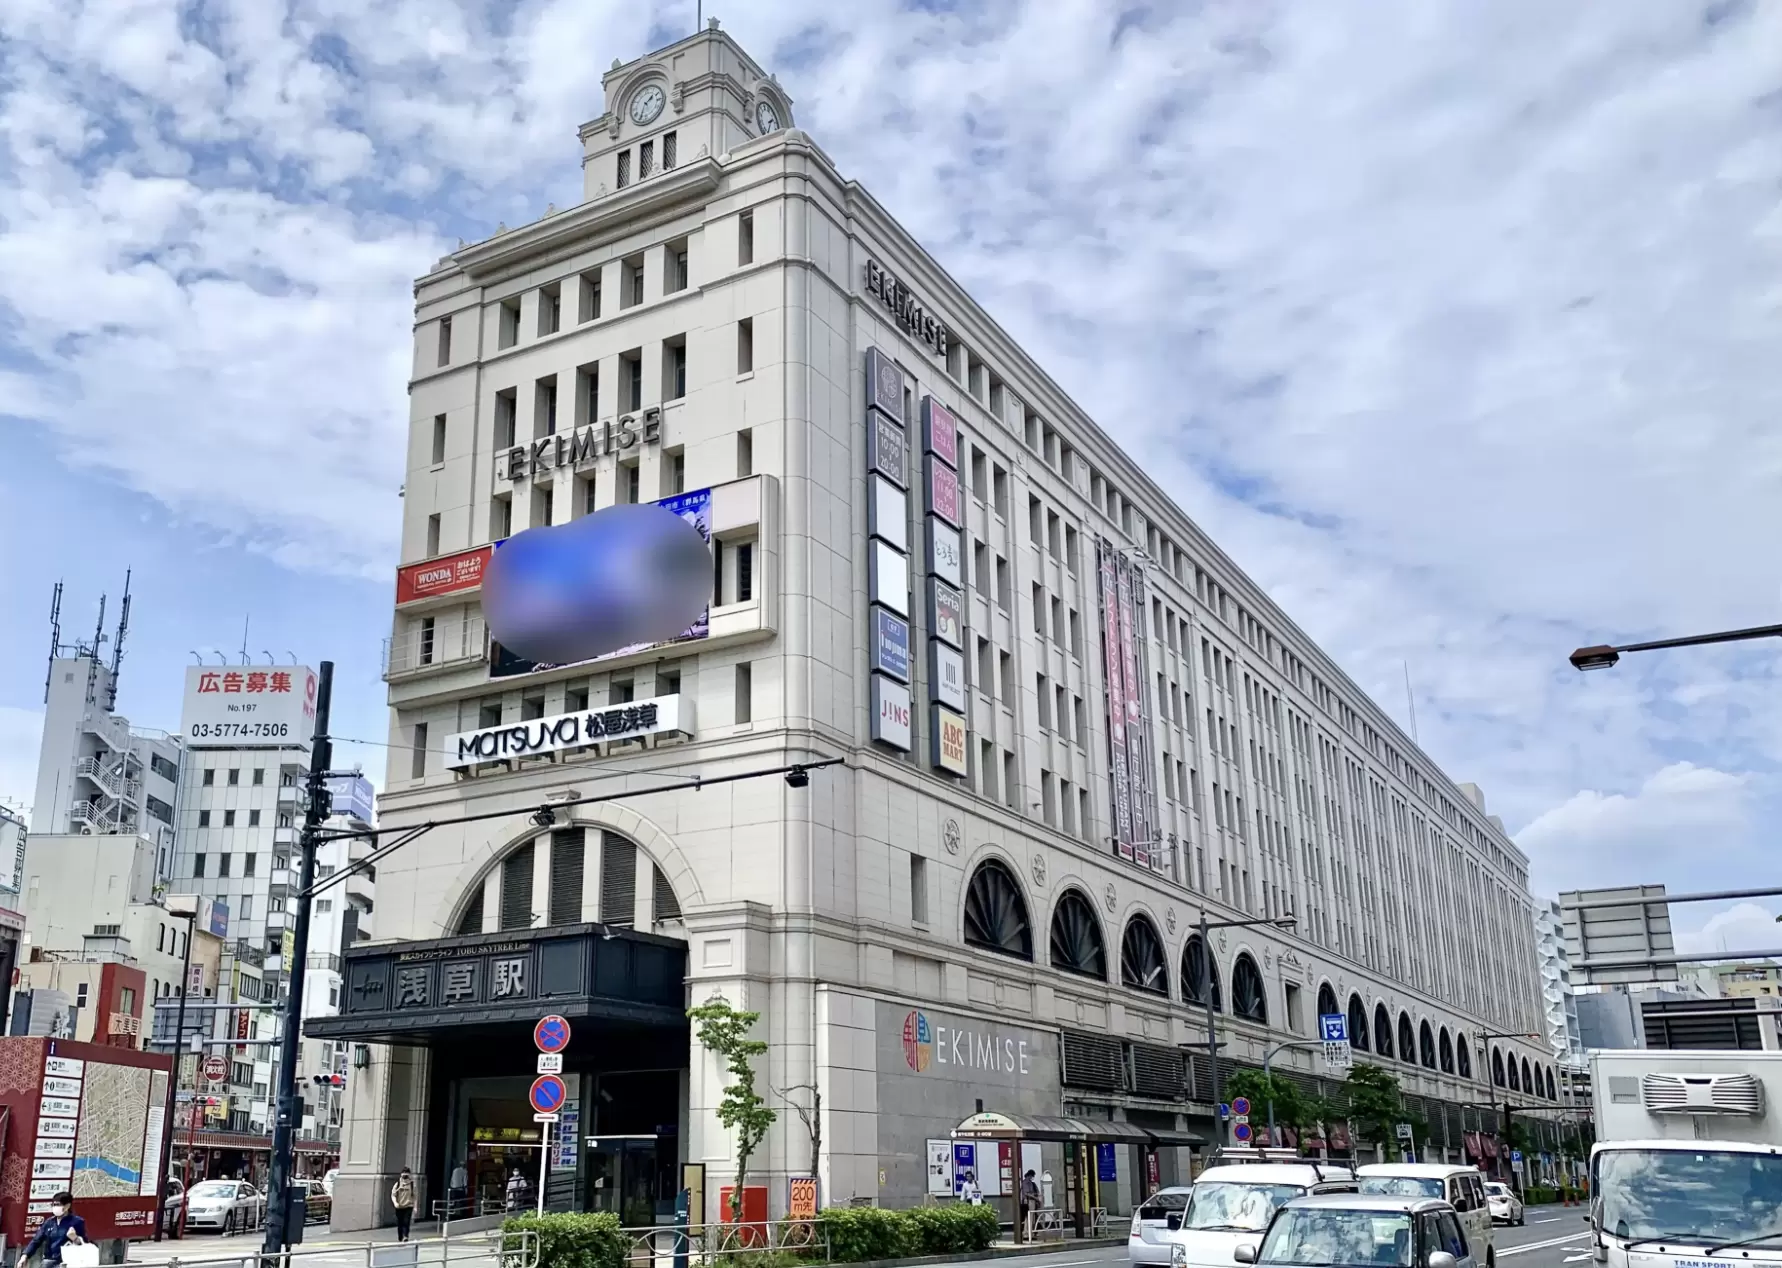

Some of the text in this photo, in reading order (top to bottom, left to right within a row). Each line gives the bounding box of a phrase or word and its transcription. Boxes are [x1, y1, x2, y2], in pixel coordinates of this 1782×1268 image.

[866, 259, 947, 356] EKIMISE
[507, 406, 660, 480] EKIMISE
[418, 568, 452, 584] WONDA
[937, 588, 960, 612] Seria
[197, 671, 292, 693] 広告募集
[227, 704, 257, 712] No.197
[192, 723, 288, 737] 03-5774-7506
[585, 703, 658, 738] 松屋浅草
[943, 721, 963, 748] ABC
[943, 742, 963, 763] MART
[456, 946, 478, 956] TOBU
[478, 942, 514, 954] SKYTREE
[514, 942, 529, 951] Line
[400, 959, 524, 1004] 浅草駅
[937, 1026, 1028, 1074] EKIMISE
[792, 1186, 815, 1202] 200
[793, 1201, 812, 1212] m先
